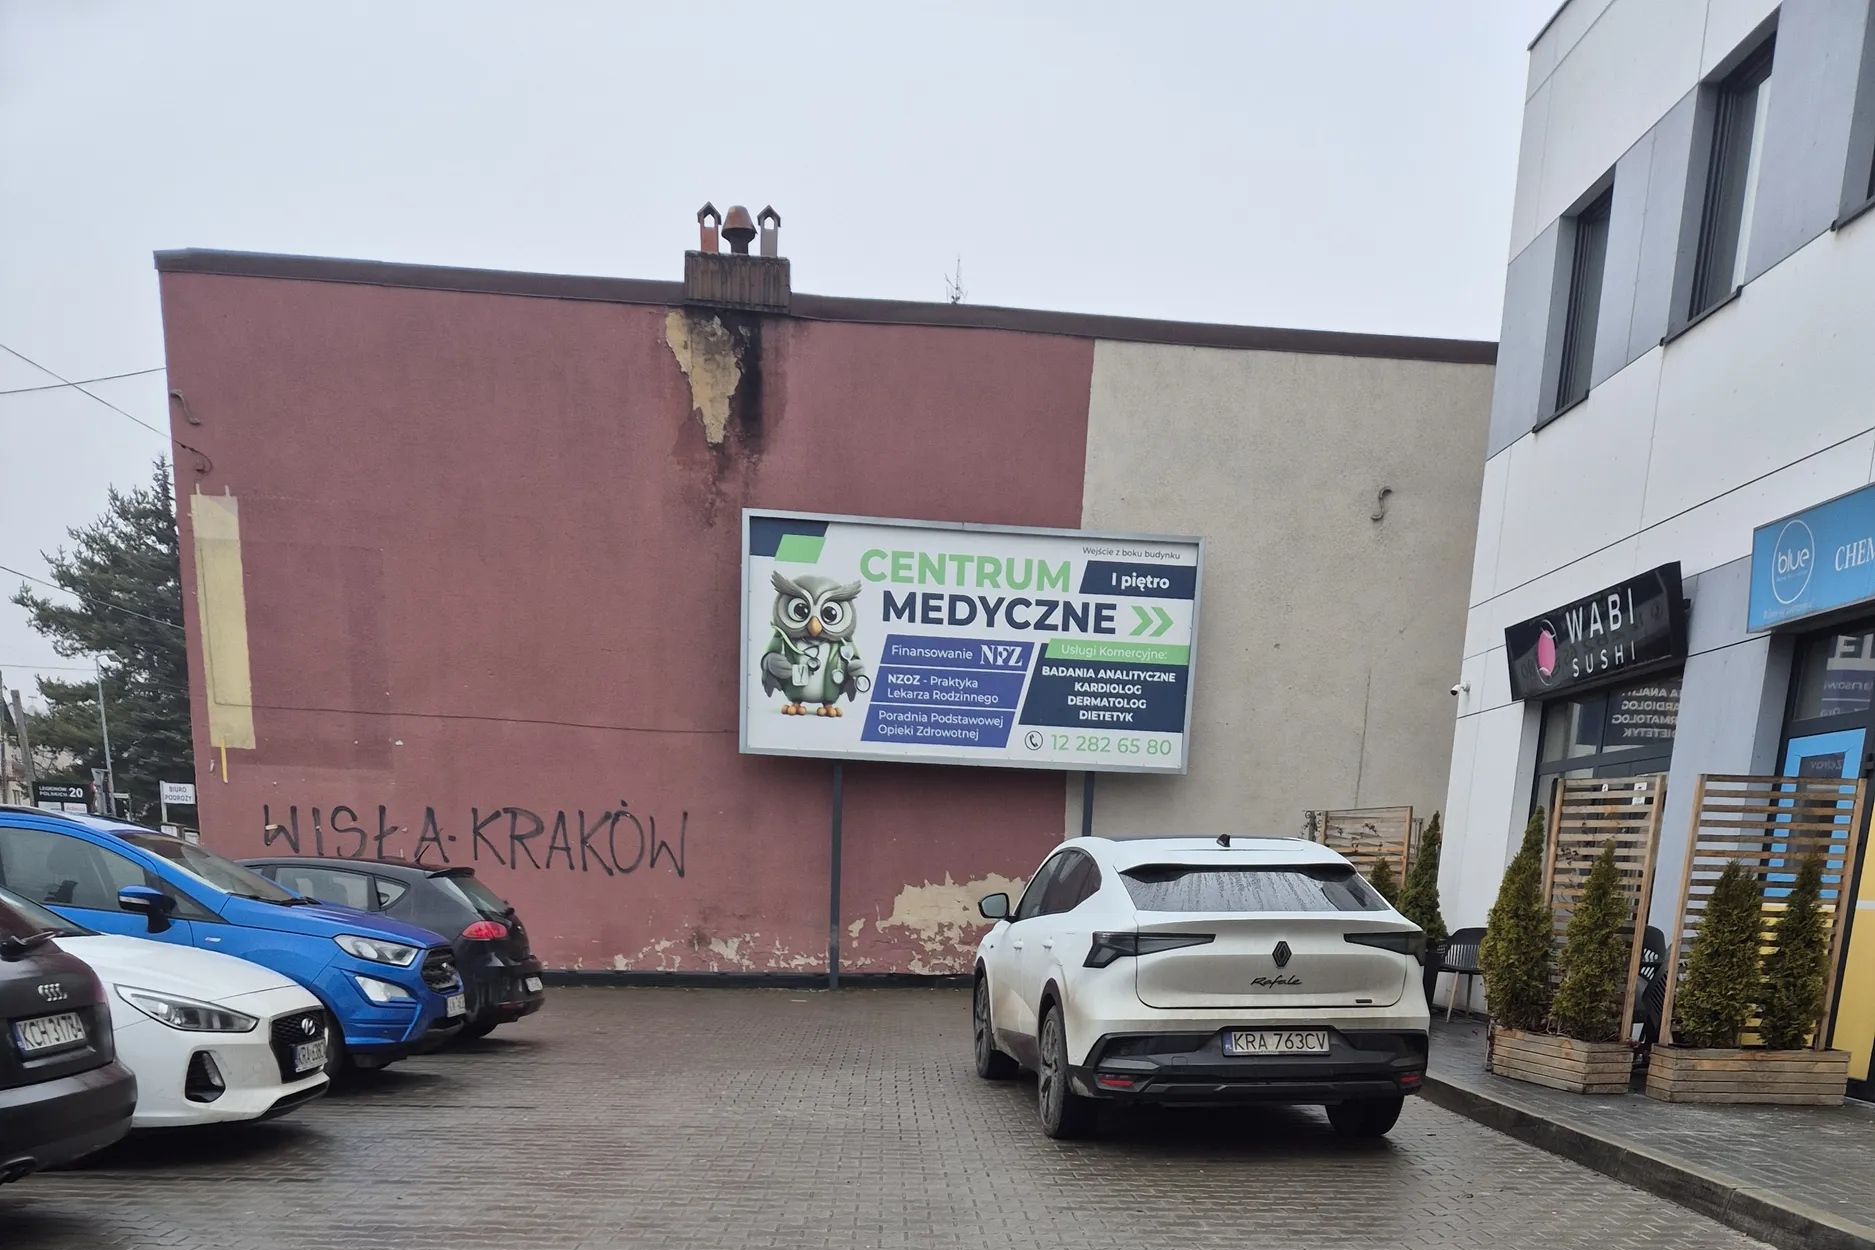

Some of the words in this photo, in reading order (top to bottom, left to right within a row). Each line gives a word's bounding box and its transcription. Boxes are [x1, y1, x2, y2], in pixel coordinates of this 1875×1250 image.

[1082, 546, 1114, 557] Wejście
[1122, 548, 1143, 558] boku
[1144, 549, 1181, 560] budynku
[1777, 547, 1810, 574] blue
[860, 548, 1070, 592] CENTRUM
[1111, 572, 1117, 585] I
[1120, 573, 1170, 591] piętro
[881, 590, 1117, 634] MEDYCZNE
[1566, 588, 1634, 644] WABI
[891, 645, 973, 659] Finansowanie
[980, 644, 1023, 666] NFZ
[1061, 644, 1096, 658] Usługi
[1100, 645, 1168, 661] Komercyjne:
[1572, 640, 1635, 677] SUSHI
[887, 673, 921, 685] NZOZ
[930, 675, 978, 689] Praktyka
[1042, 666, 1095, 678] BADANIA
[1098, 668, 1177, 682] ANALITYCZNE
[887, 688, 930, 700] Lekarza
[933, 690, 999, 705] Rodzinnego
[1074, 682, 1142, 695] KARDIOLOG
[1068, 695, 1147, 709] DERMATOLOG
[878, 710, 927, 722] Poradnia
[930, 713, 1004, 728] Podstawowej
[1079, 710, 1133, 722] DIETETYK
[878, 724, 914, 736] Opieki
[916, 725, 980, 741] Zdrowotnej
[1051, 734, 1069, 750] 12
[1075, 735, 1111, 753] 282
[1117, 738, 1140, 754] 65
[1146, 739, 1172, 756] 80
[69, 787, 83, 798] 20
[169, 785, 187, 793] BIURO
[470, 800, 688, 878] KRAKÓW
[1250, 974, 1302, 988] Rafale
[17, 1018, 52, 1048] KCH
[1233, 1033, 1268, 1050] KRA
[1273, 1032, 1326, 1050] 763CV
